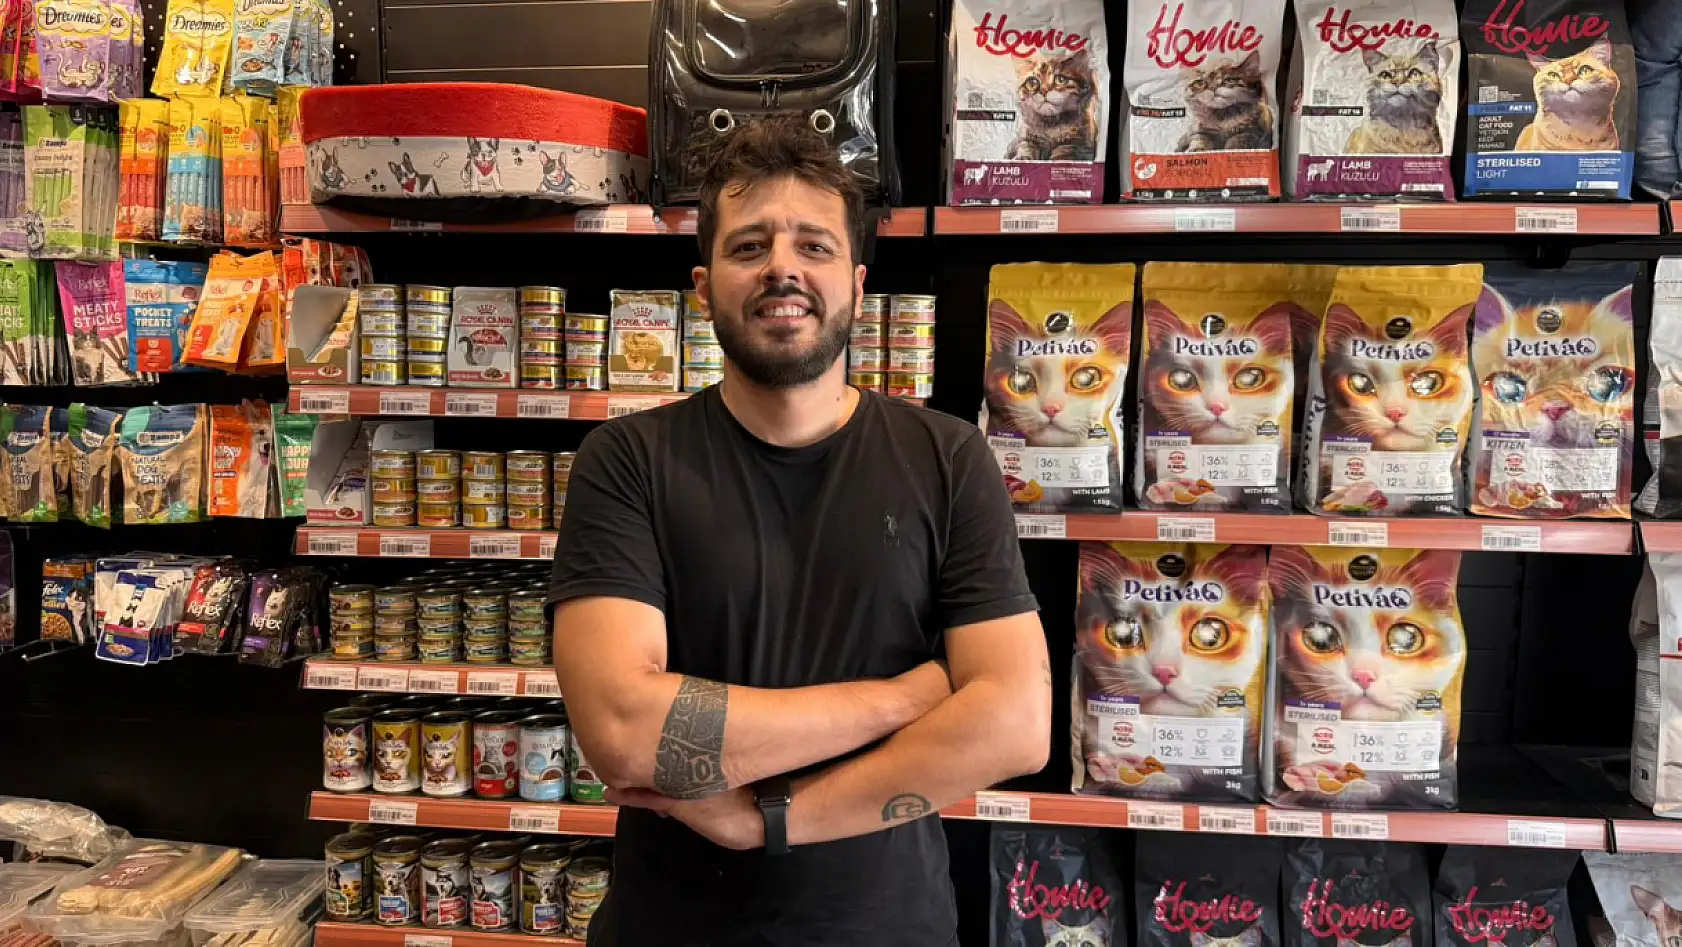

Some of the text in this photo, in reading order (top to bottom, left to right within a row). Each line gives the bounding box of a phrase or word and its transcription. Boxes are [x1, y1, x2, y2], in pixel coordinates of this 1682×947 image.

[45, 6, 102, 25] Dreamies
[172, 14, 226, 31] Dreamies
[1481, 0, 1610, 56] Homie
[974, 12, 1091, 58] Homie
[1316, 7, 1439, 53] Homie
[1146, 3, 1264, 69] Homie
[1166, 158, 1208, 168] SALMON
[1342, 160, 1371, 169] LAMB
[1477, 157, 1541, 168] STERILISED
[993, 166, 1020, 175] LAMB
[1476, 169, 1507, 179] LIGHT
[992, 177, 1030, 186] KUZULU
[1341, 172, 1380, 182] KUZULU
[74, 301, 119, 317] MEATY
[134, 308, 173, 317] POCKET
[74, 313, 123, 328] STICKS
[135, 318, 173, 328] TREATS
[1486, 440, 1527, 450] KITTEN
[1040, 457, 1061, 469] 36%
[1206, 456, 1229, 466] 36%
[1041, 472, 1062, 481] 12%
[1207, 471, 1229, 480] 12%
[187, 601, 223, 618] Reflex
[250, 612, 283, 631] Reflex
[1090, 704, 1137, 716] STERILISED
[1287, 710, 1338, 722] STERILISED
[1159, 729, 1185, 741] 36%
[1359, 735, 1385, 746] 36%
[1159, 746, 1184, 757] 12%
[1360, 752, 1385, 763] 12%
[1225, 768, 1243, 776] FISH
[1402, 772, 1440, 781] WITH FISH
[1008, 857, 1110, 920] Homie
[1154, 879, 1264, 932] Homie
[1302, 877, 1415, 939] Homie
[1448, 886, 1555, 943] Homie
